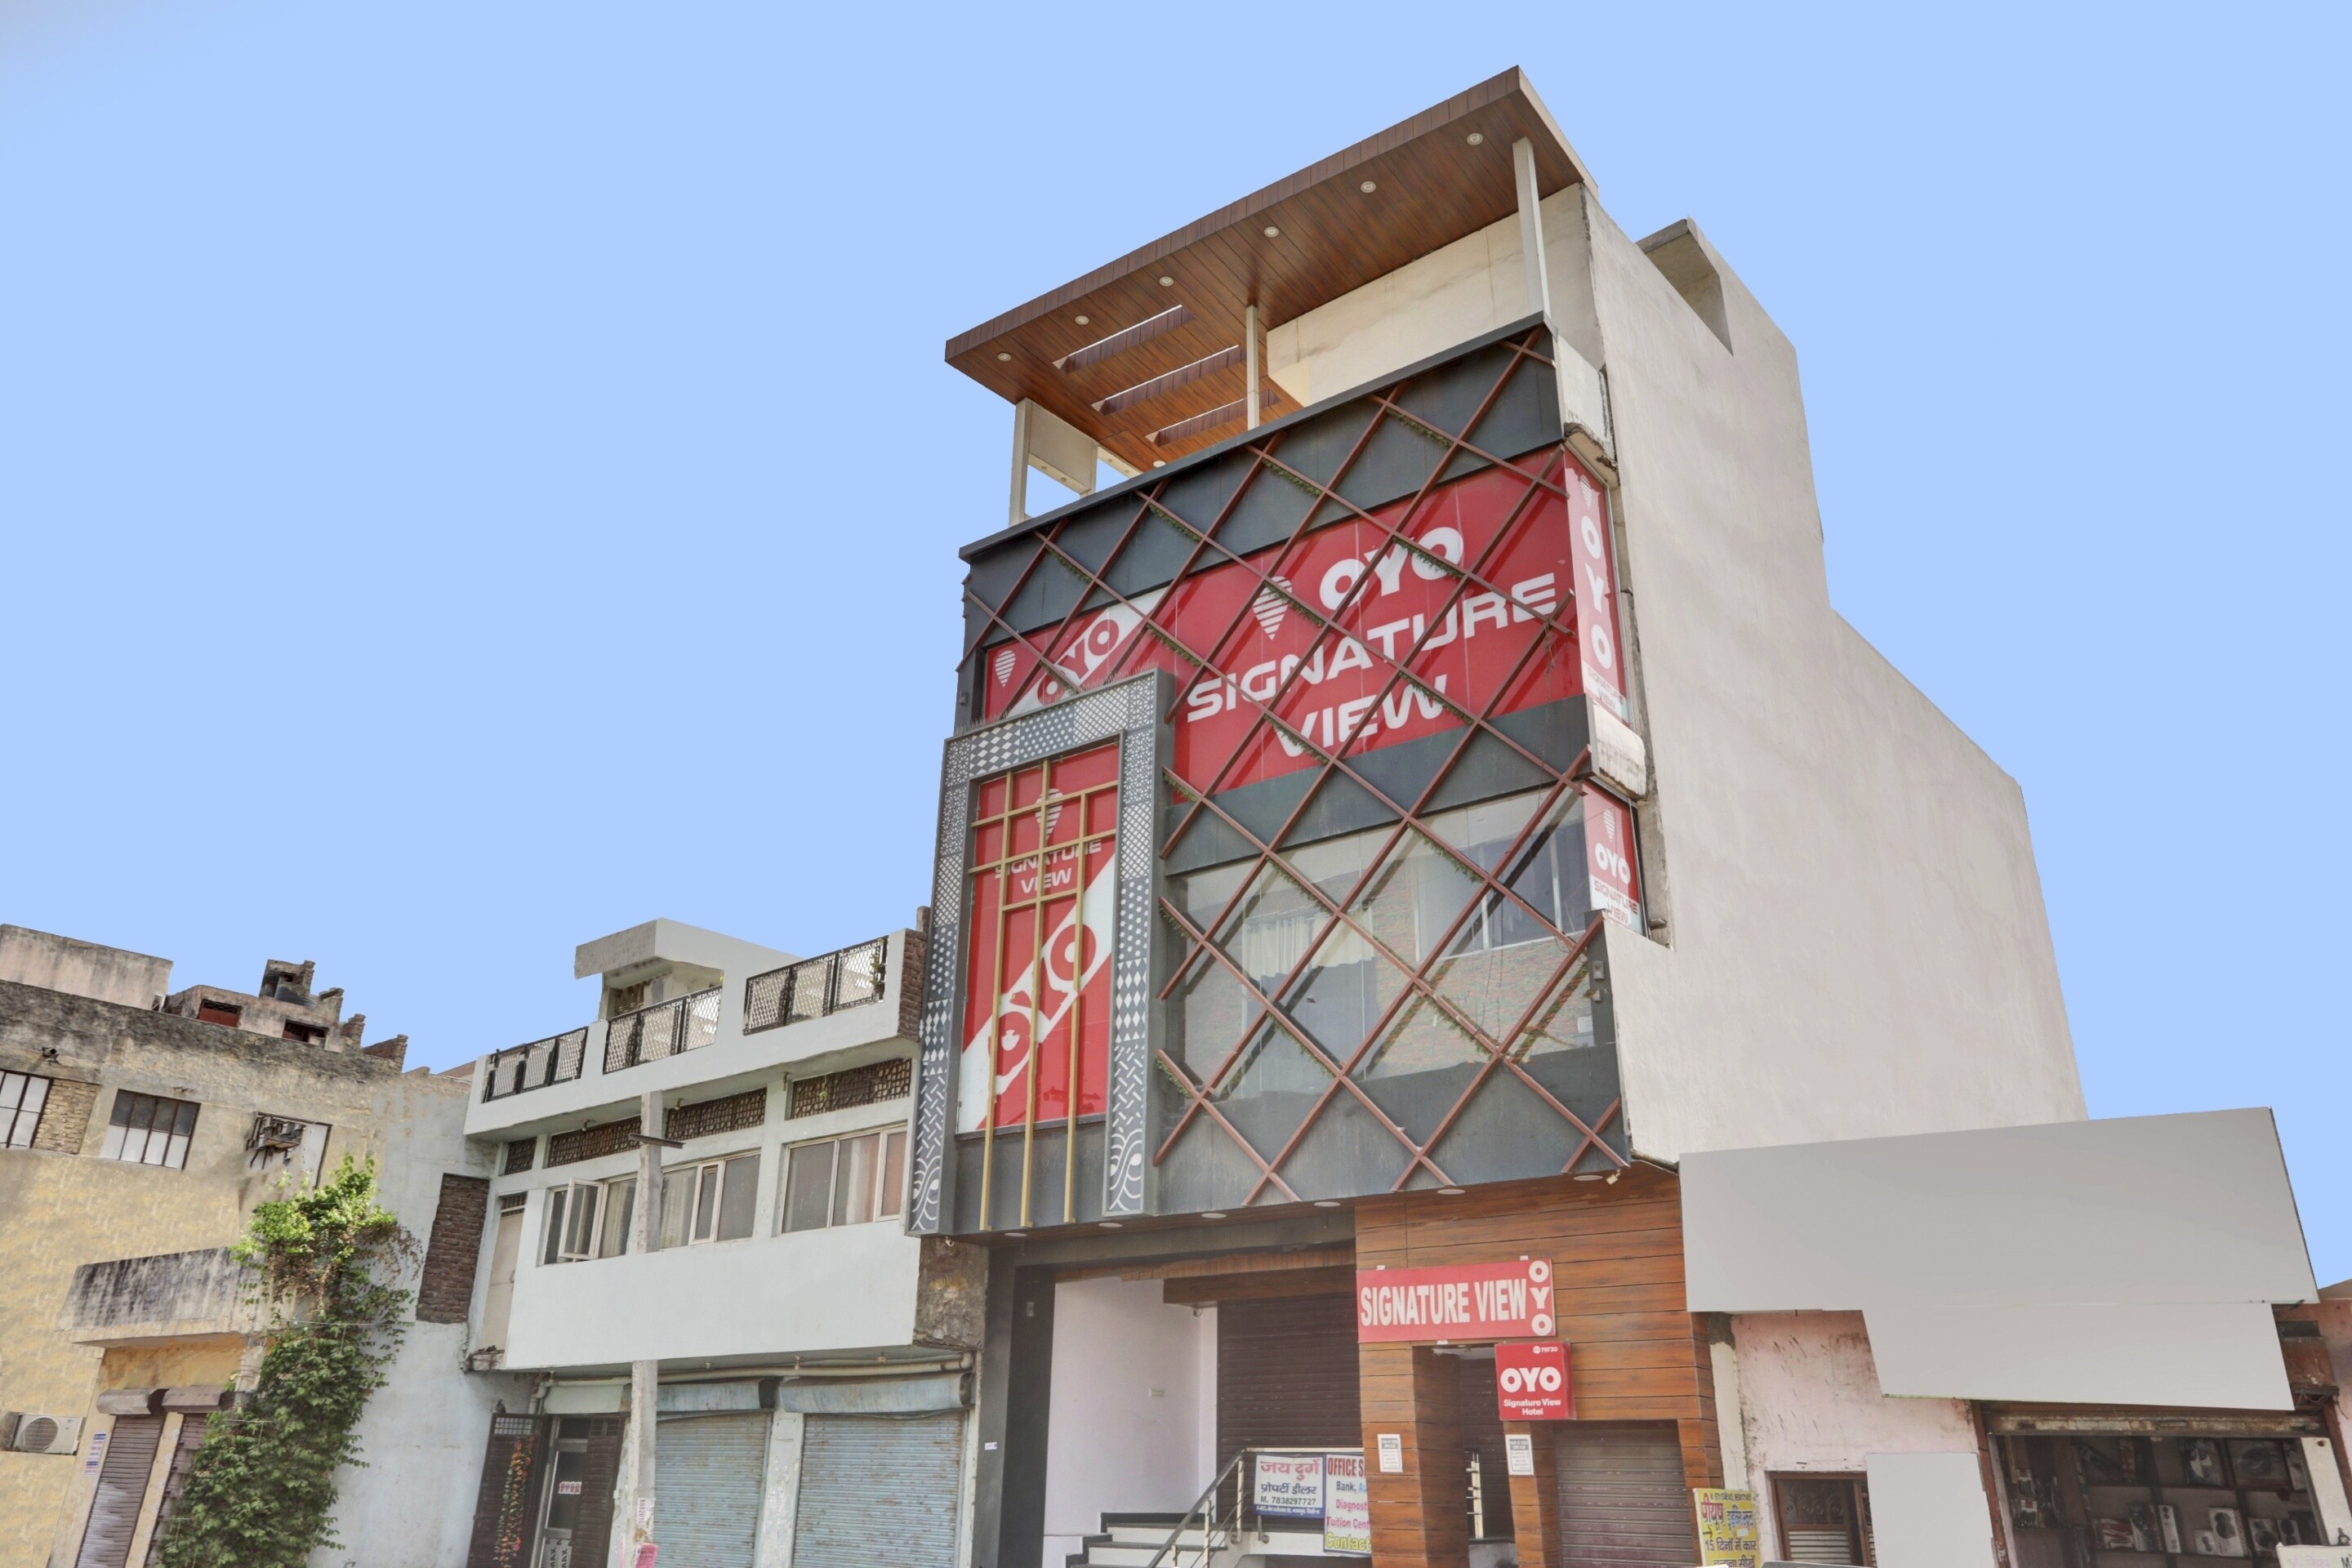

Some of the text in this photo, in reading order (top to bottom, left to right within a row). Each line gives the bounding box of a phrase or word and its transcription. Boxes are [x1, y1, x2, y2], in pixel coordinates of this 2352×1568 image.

[1320, 527, 1464, 611] OYO
[1580, 515, 1612, 670] OYO
[1187, 572, 1557, 724] SIGNATURE
[1276, 674, 1448, 758] VIEW
[1594, 842, 1631, 885] OYO
[1361, 1278, 1527, 1326] SIGNATURE VIEW
[1528, 1260, 1552, 1336] OYO
[1500, 1366, 1561, 1393] OYO
[1503, 1398, 1561, 1408] Signature View
[1260, 1461, 1291, 1475] जय
[1328, 1458, 1356, 1477] OFFICE
[1336, 1481, 1356, 1494] Bank,
[1272, 1496, 1316, 1505] 7838297727
[1326, 1517, 1351, 1527] Tuition
[1325, 1531, 1371, 1552] Contact
[1705, 1539, 1714, 1551] 15
